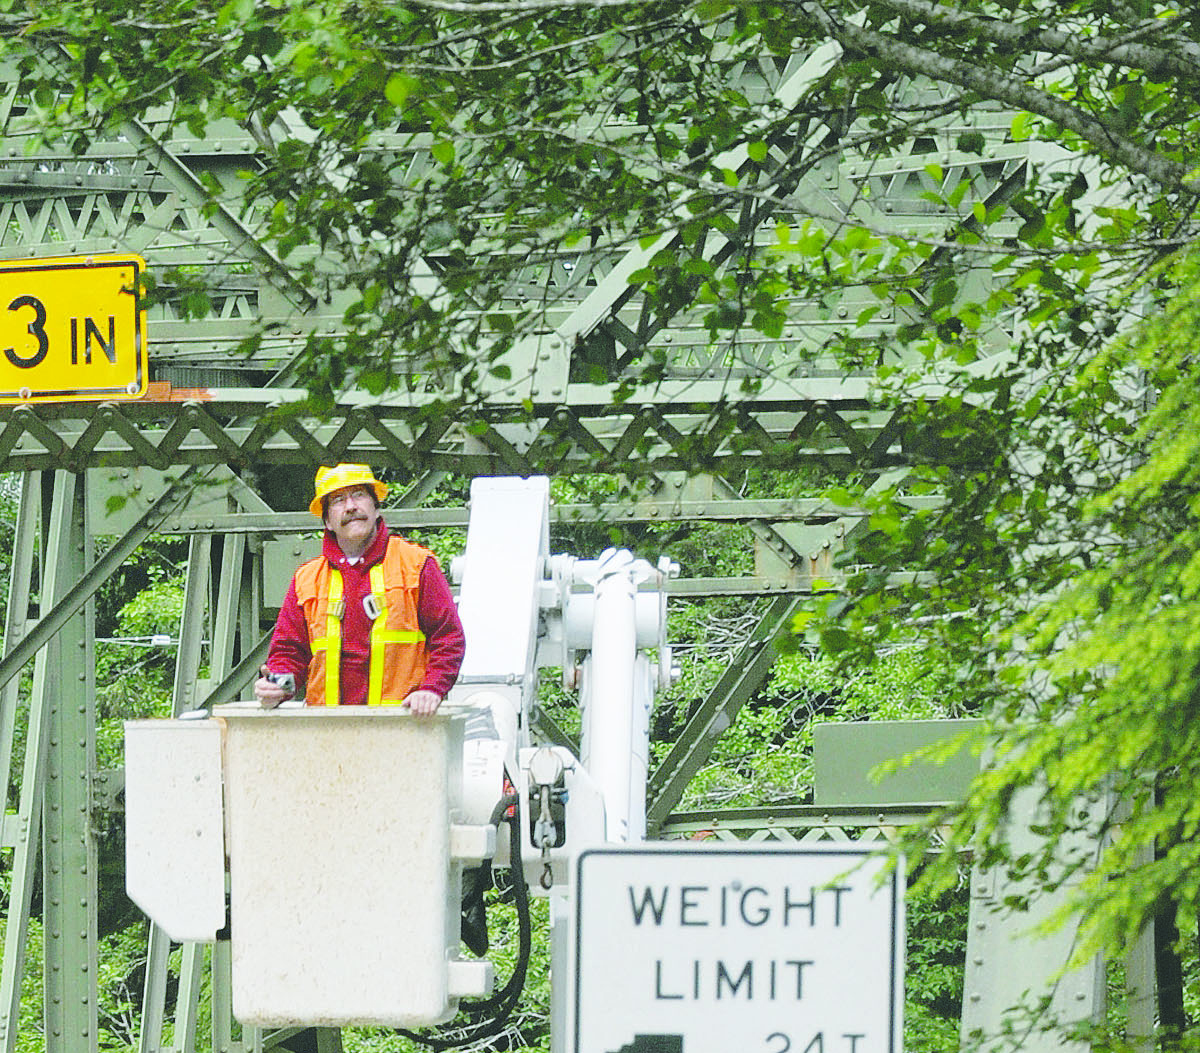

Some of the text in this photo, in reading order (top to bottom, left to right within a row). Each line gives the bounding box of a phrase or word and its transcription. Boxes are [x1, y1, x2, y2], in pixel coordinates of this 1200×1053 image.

[3, 294, 50, 369] 3
[69, 315, 117, 366] IN
[628, 885, 853, 928] WEIGHT
[654, 959, 816, 1001] LIMIT
